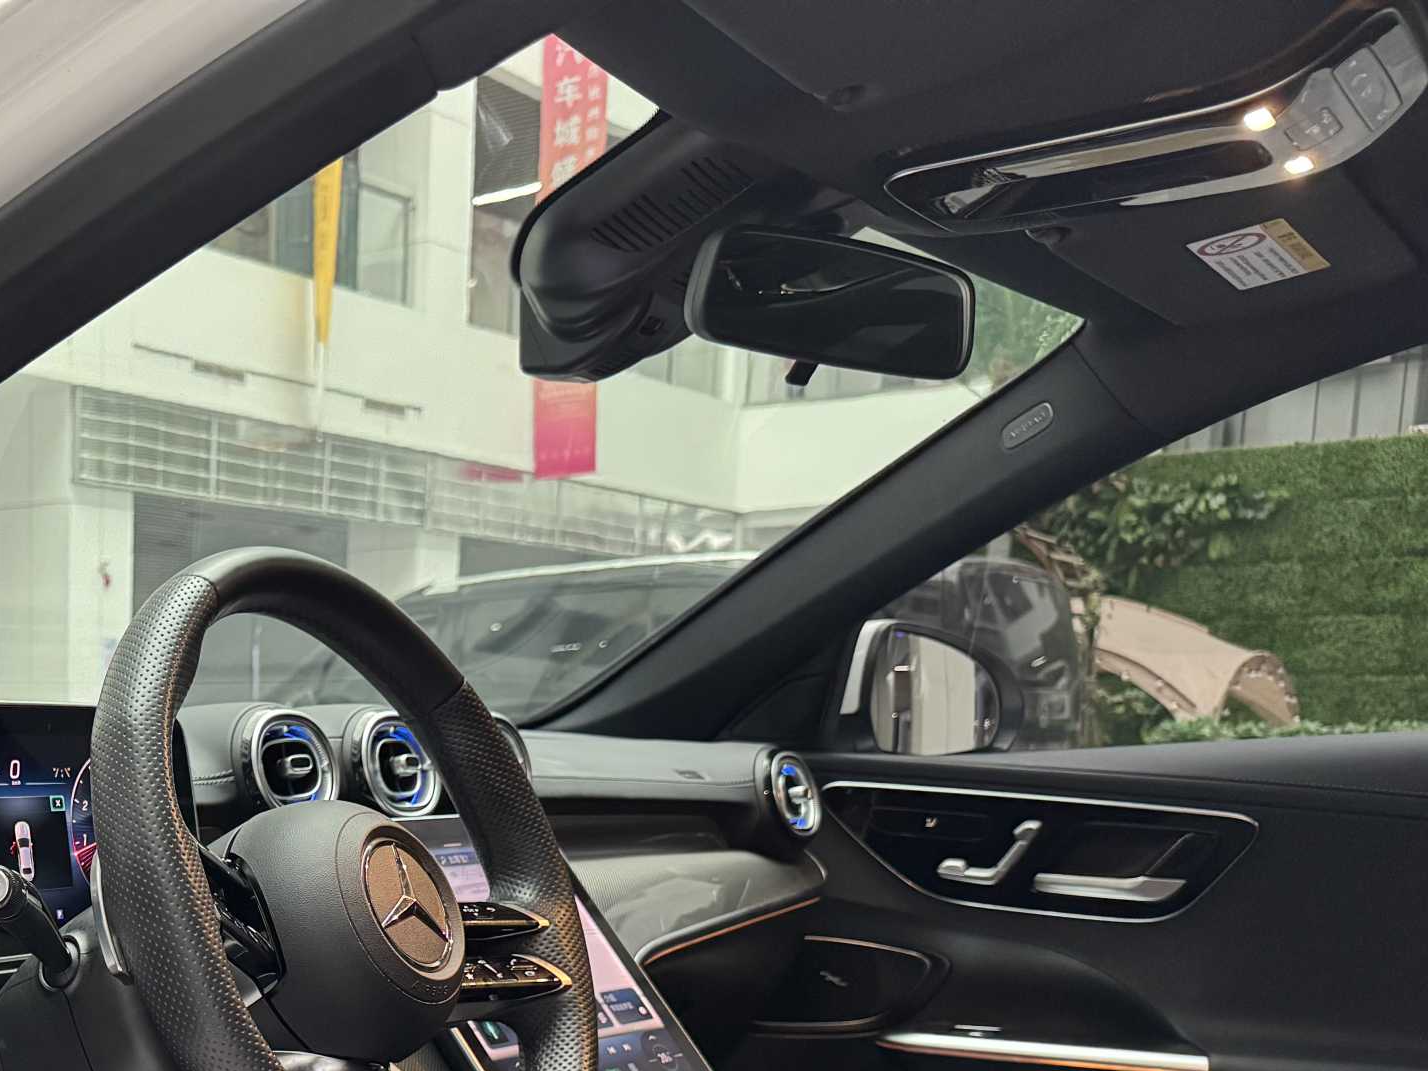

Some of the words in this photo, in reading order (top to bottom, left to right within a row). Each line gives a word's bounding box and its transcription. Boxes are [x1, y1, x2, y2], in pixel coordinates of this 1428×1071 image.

[9, 759, 21, 779] 0
[82, 800, 88, 811] 2
[83, 833, 87, 846] 1
